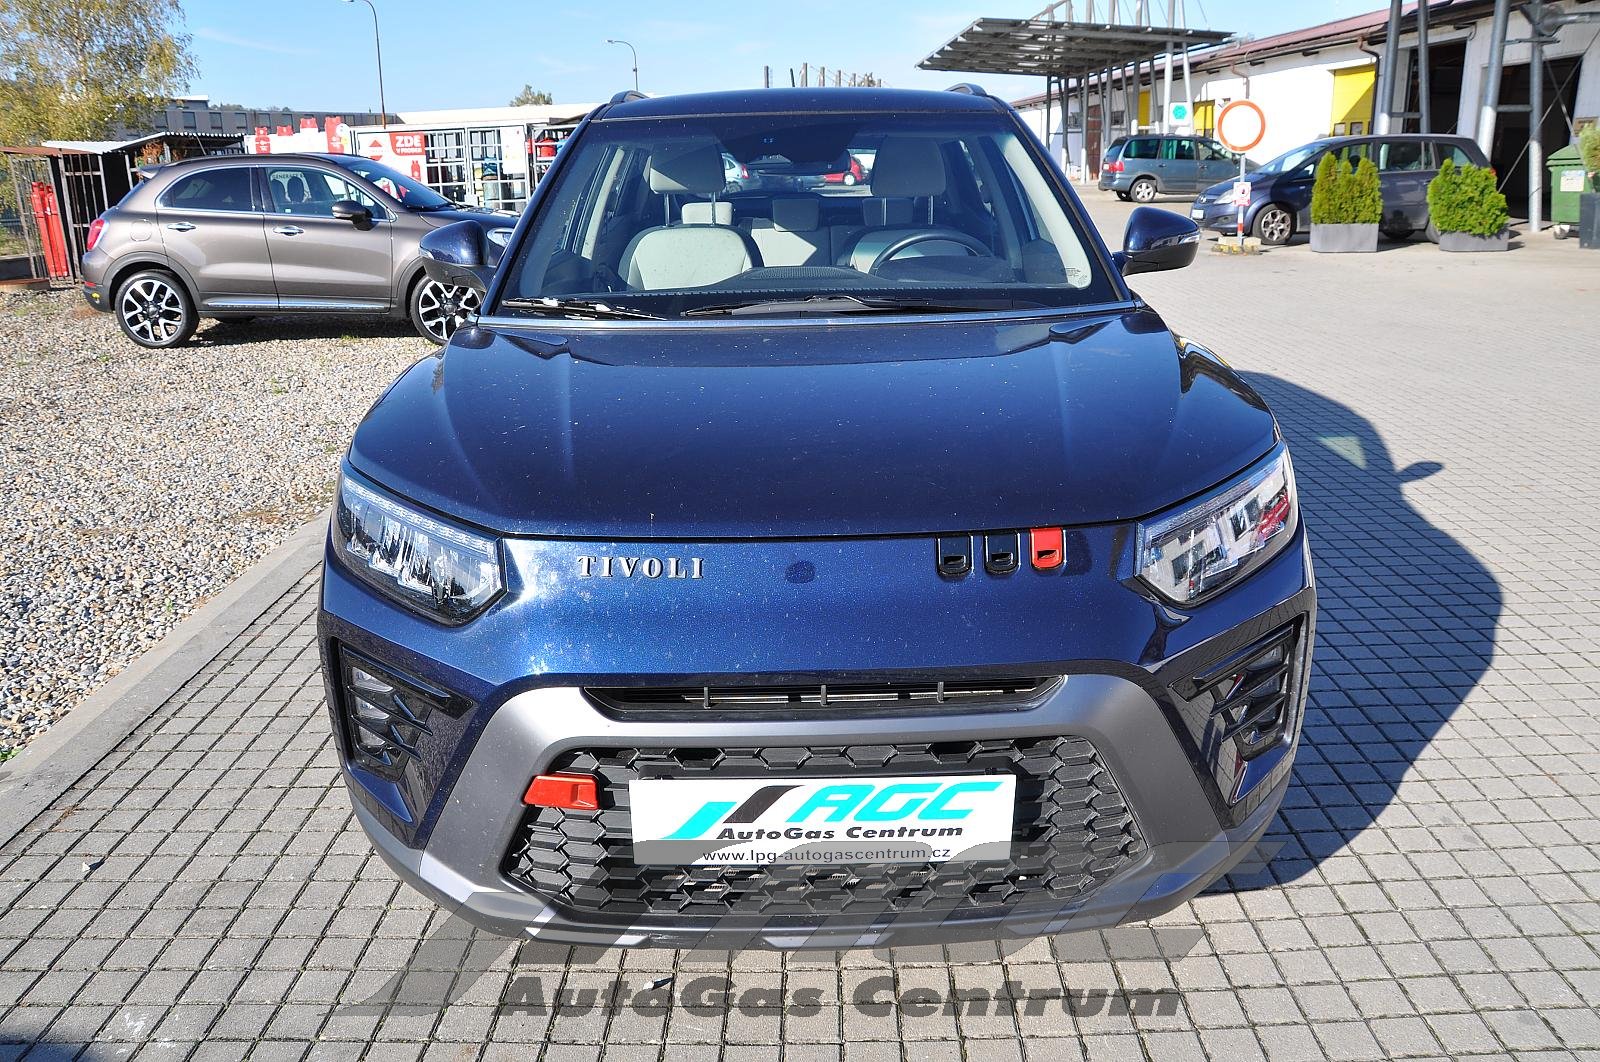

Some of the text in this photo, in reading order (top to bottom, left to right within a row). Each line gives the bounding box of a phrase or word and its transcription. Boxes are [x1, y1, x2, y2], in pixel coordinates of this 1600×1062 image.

[395, 134, 421, 148] ZDE
[576, 555, 704, 579] TIVOLI
[785, 781, 1004, 822] AGC
[716, 825, 964, 841] AutoGas Centrum
[703, 847, 951, 864] www.lpg-autogascentrum.cz
